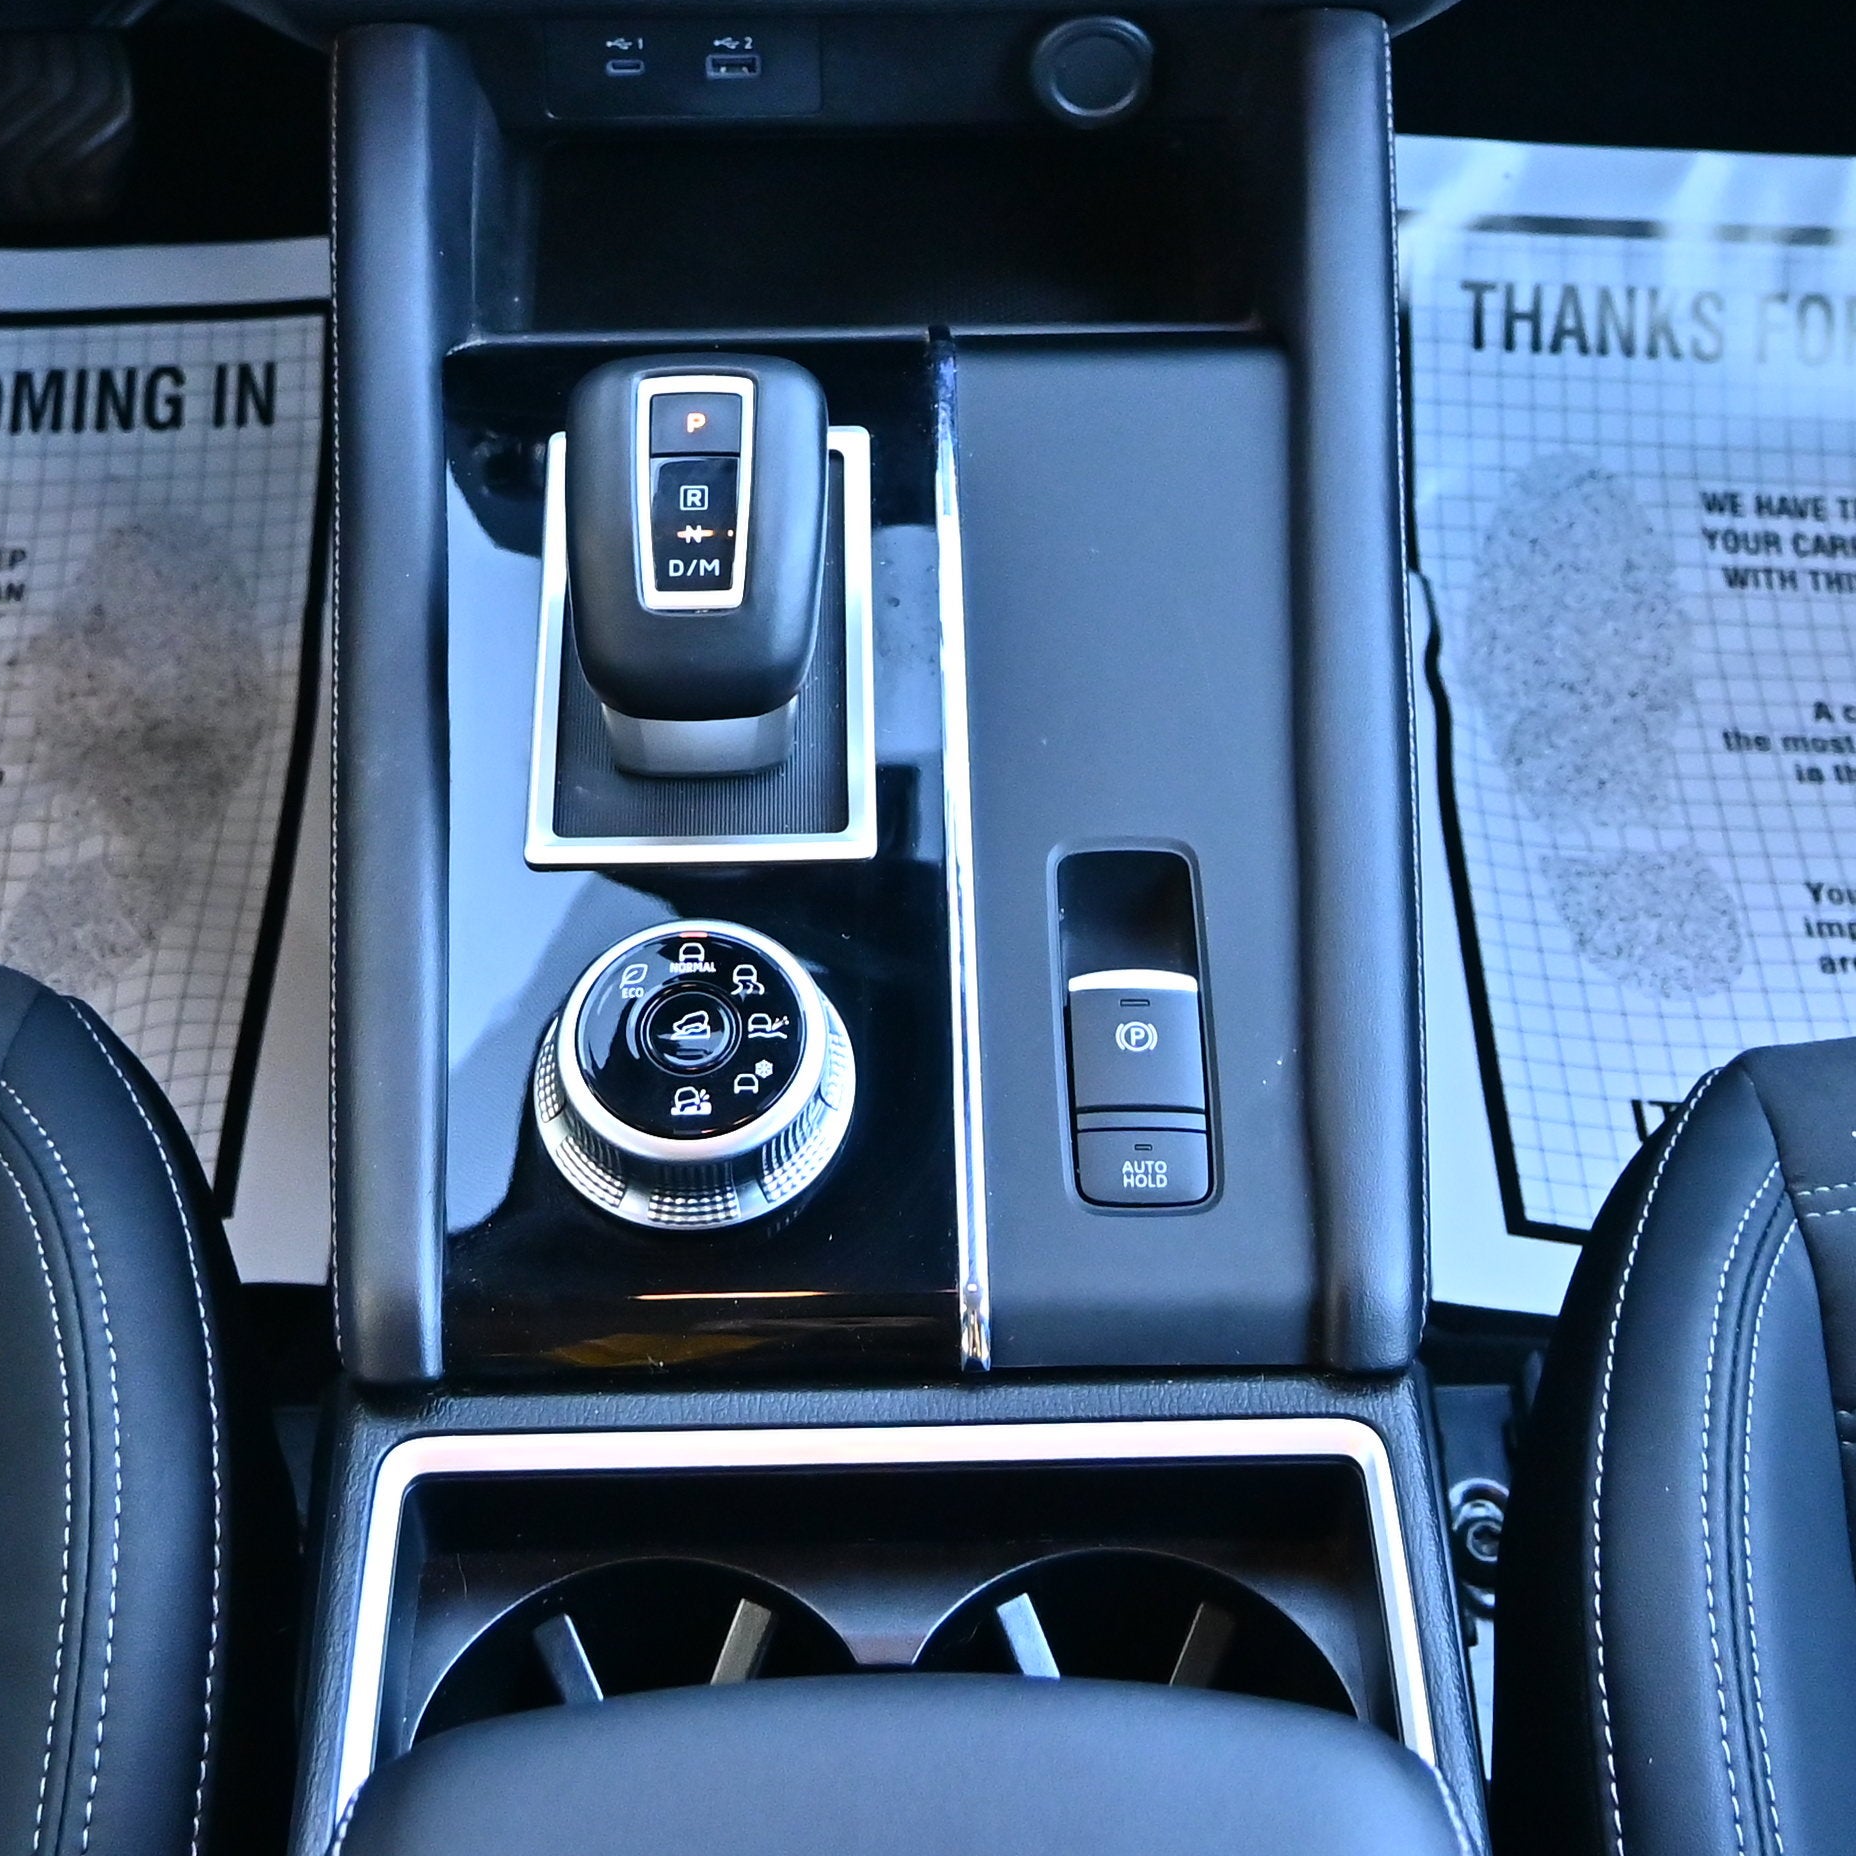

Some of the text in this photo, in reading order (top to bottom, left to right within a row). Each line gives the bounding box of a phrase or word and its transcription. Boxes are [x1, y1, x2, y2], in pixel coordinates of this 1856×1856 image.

[744, 37, 753, 49] 2
[1460, 279, 1726, 364] THANKS
[213, 360, 279, 430] IN
[686, 412, 706, 433] P
[686, 489, 702, 507] R
[1700, 491, 1743, 518] WE
[1755, 494, 1828, 523] HAVE
[685, 525, 703, 543] N
[1701, 526, 1782, 557] YOUR
[668, 559, 720, 577] D/M
[1722, 567, 1798, 592] WITH
[1813, 701, 1834, 724] A
[1722, 729, 1770, 753] the
[1795, 763, 1825, 786] in
[669, 962, 716, 974] NORMAL
[621, 987, 645, 999] ECO
[1122, 1160, 1168, 1174] AUTO
[1123, 1174, 1168, 1188] HOLD
